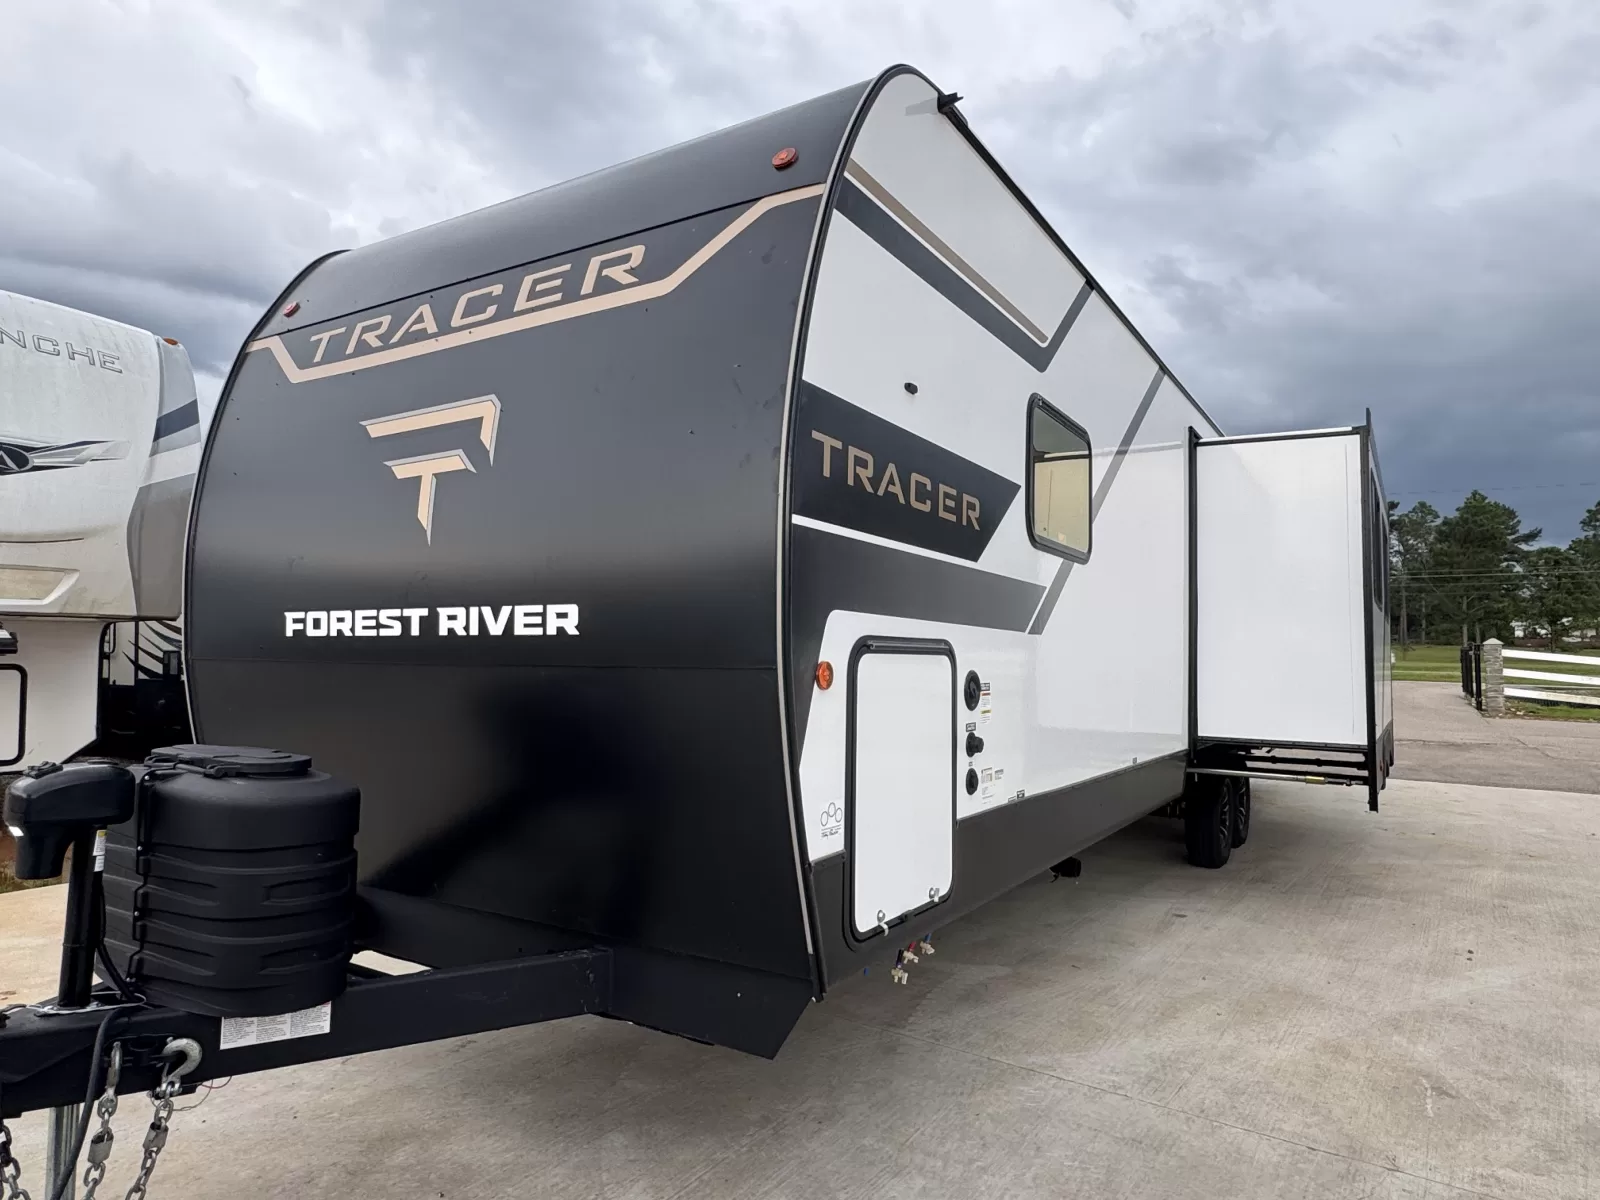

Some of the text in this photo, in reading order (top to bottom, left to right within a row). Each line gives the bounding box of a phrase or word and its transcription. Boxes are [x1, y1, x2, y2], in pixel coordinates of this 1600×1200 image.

[310, 244, 646, 363] TRACER
[811, 429, 981, 531] TRACER
[284, 603, 580, 638] FOREST RIVER
